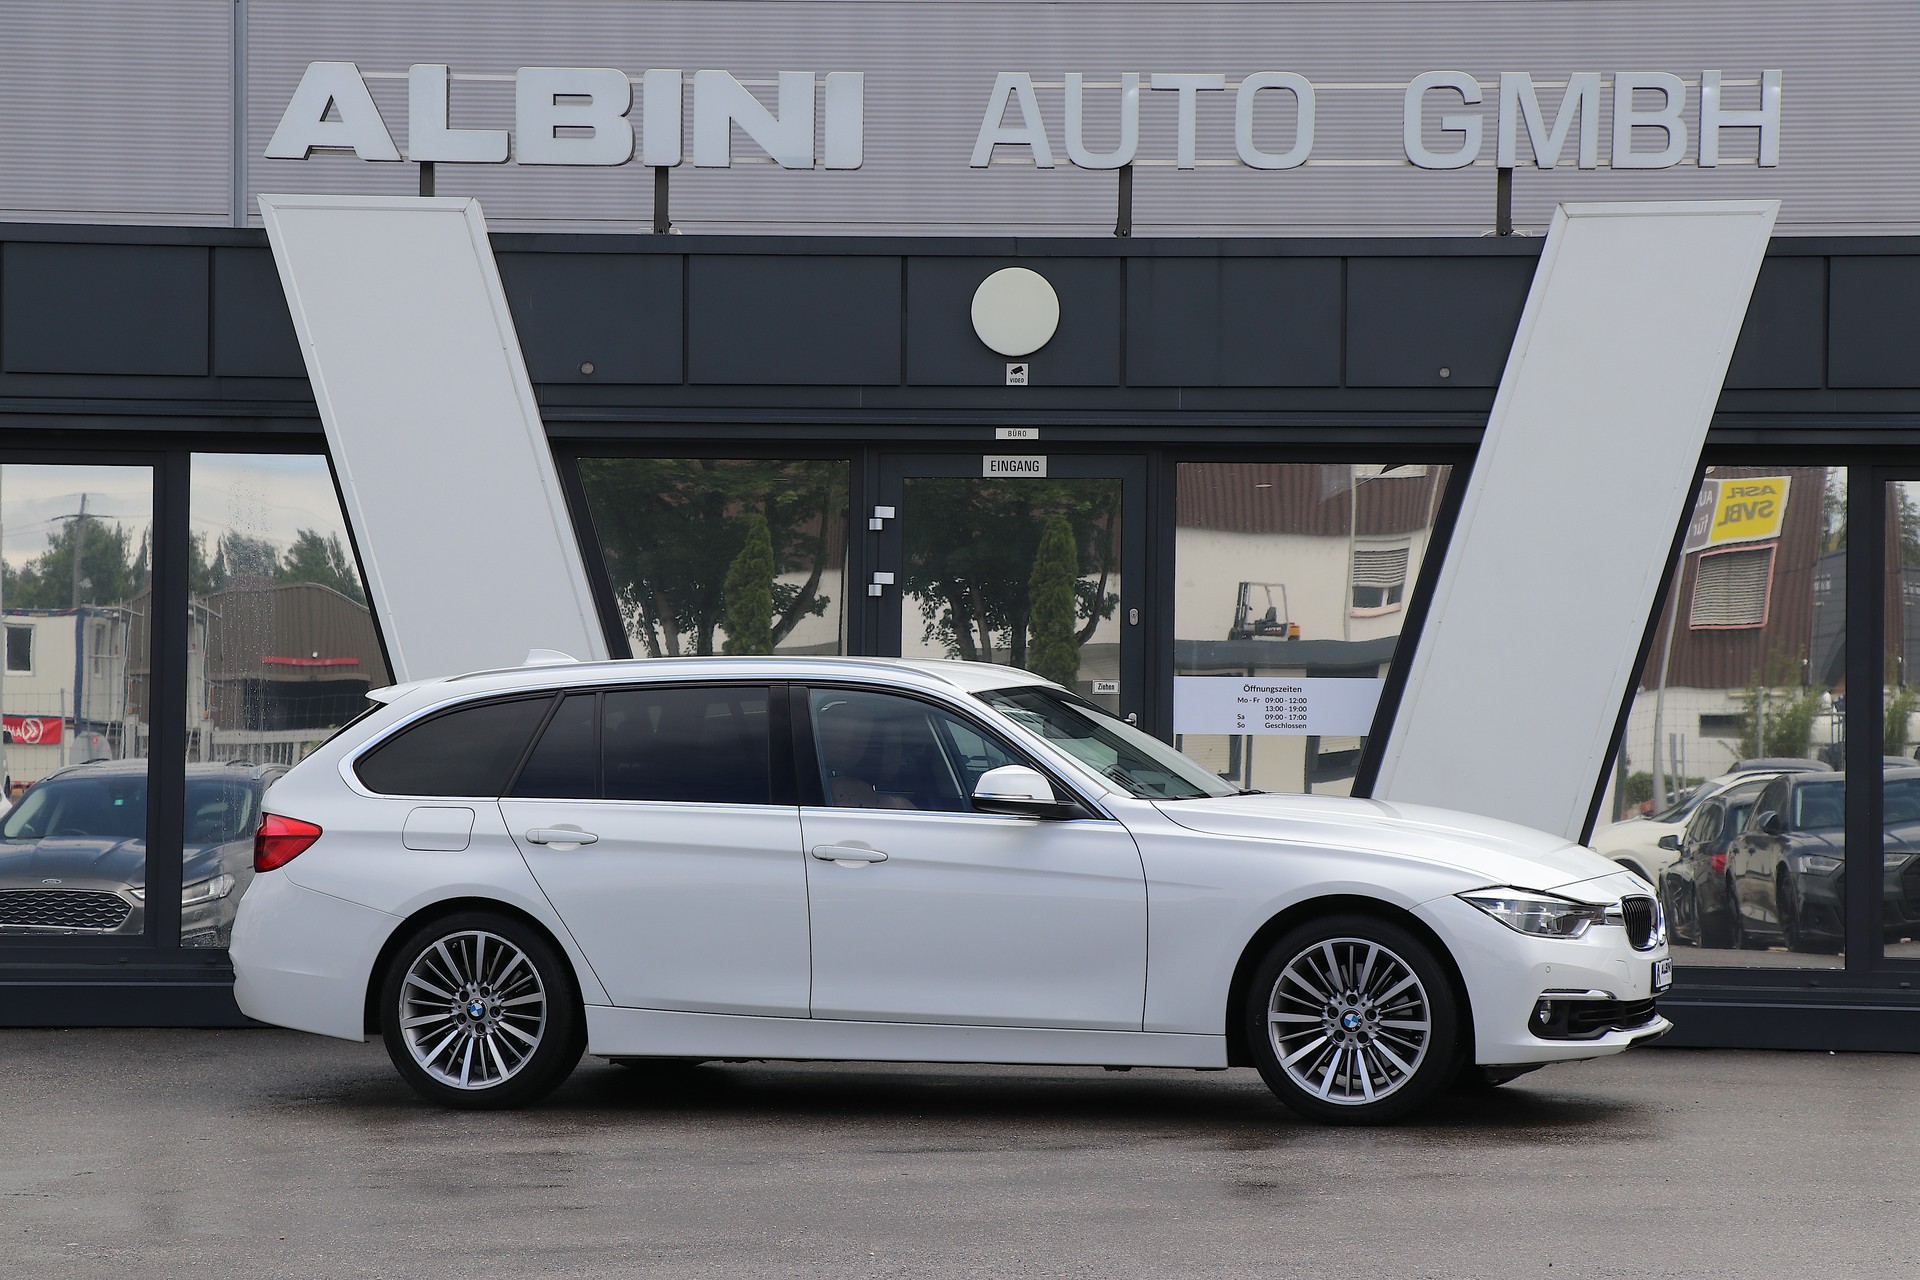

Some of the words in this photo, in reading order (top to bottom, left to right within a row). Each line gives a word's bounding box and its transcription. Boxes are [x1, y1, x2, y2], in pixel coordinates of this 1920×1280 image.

[264, 61, 865, 170] ALBINI
[969, 70, 1317, 170] AUTO
[1402, 69, 1783, 170] GMBH
[1007, 428, 1027, 437] BÜRO
[990, 460, 1040, 472] EINGANG
[1243, 684, 1302, 694] Öffnungszeiten
